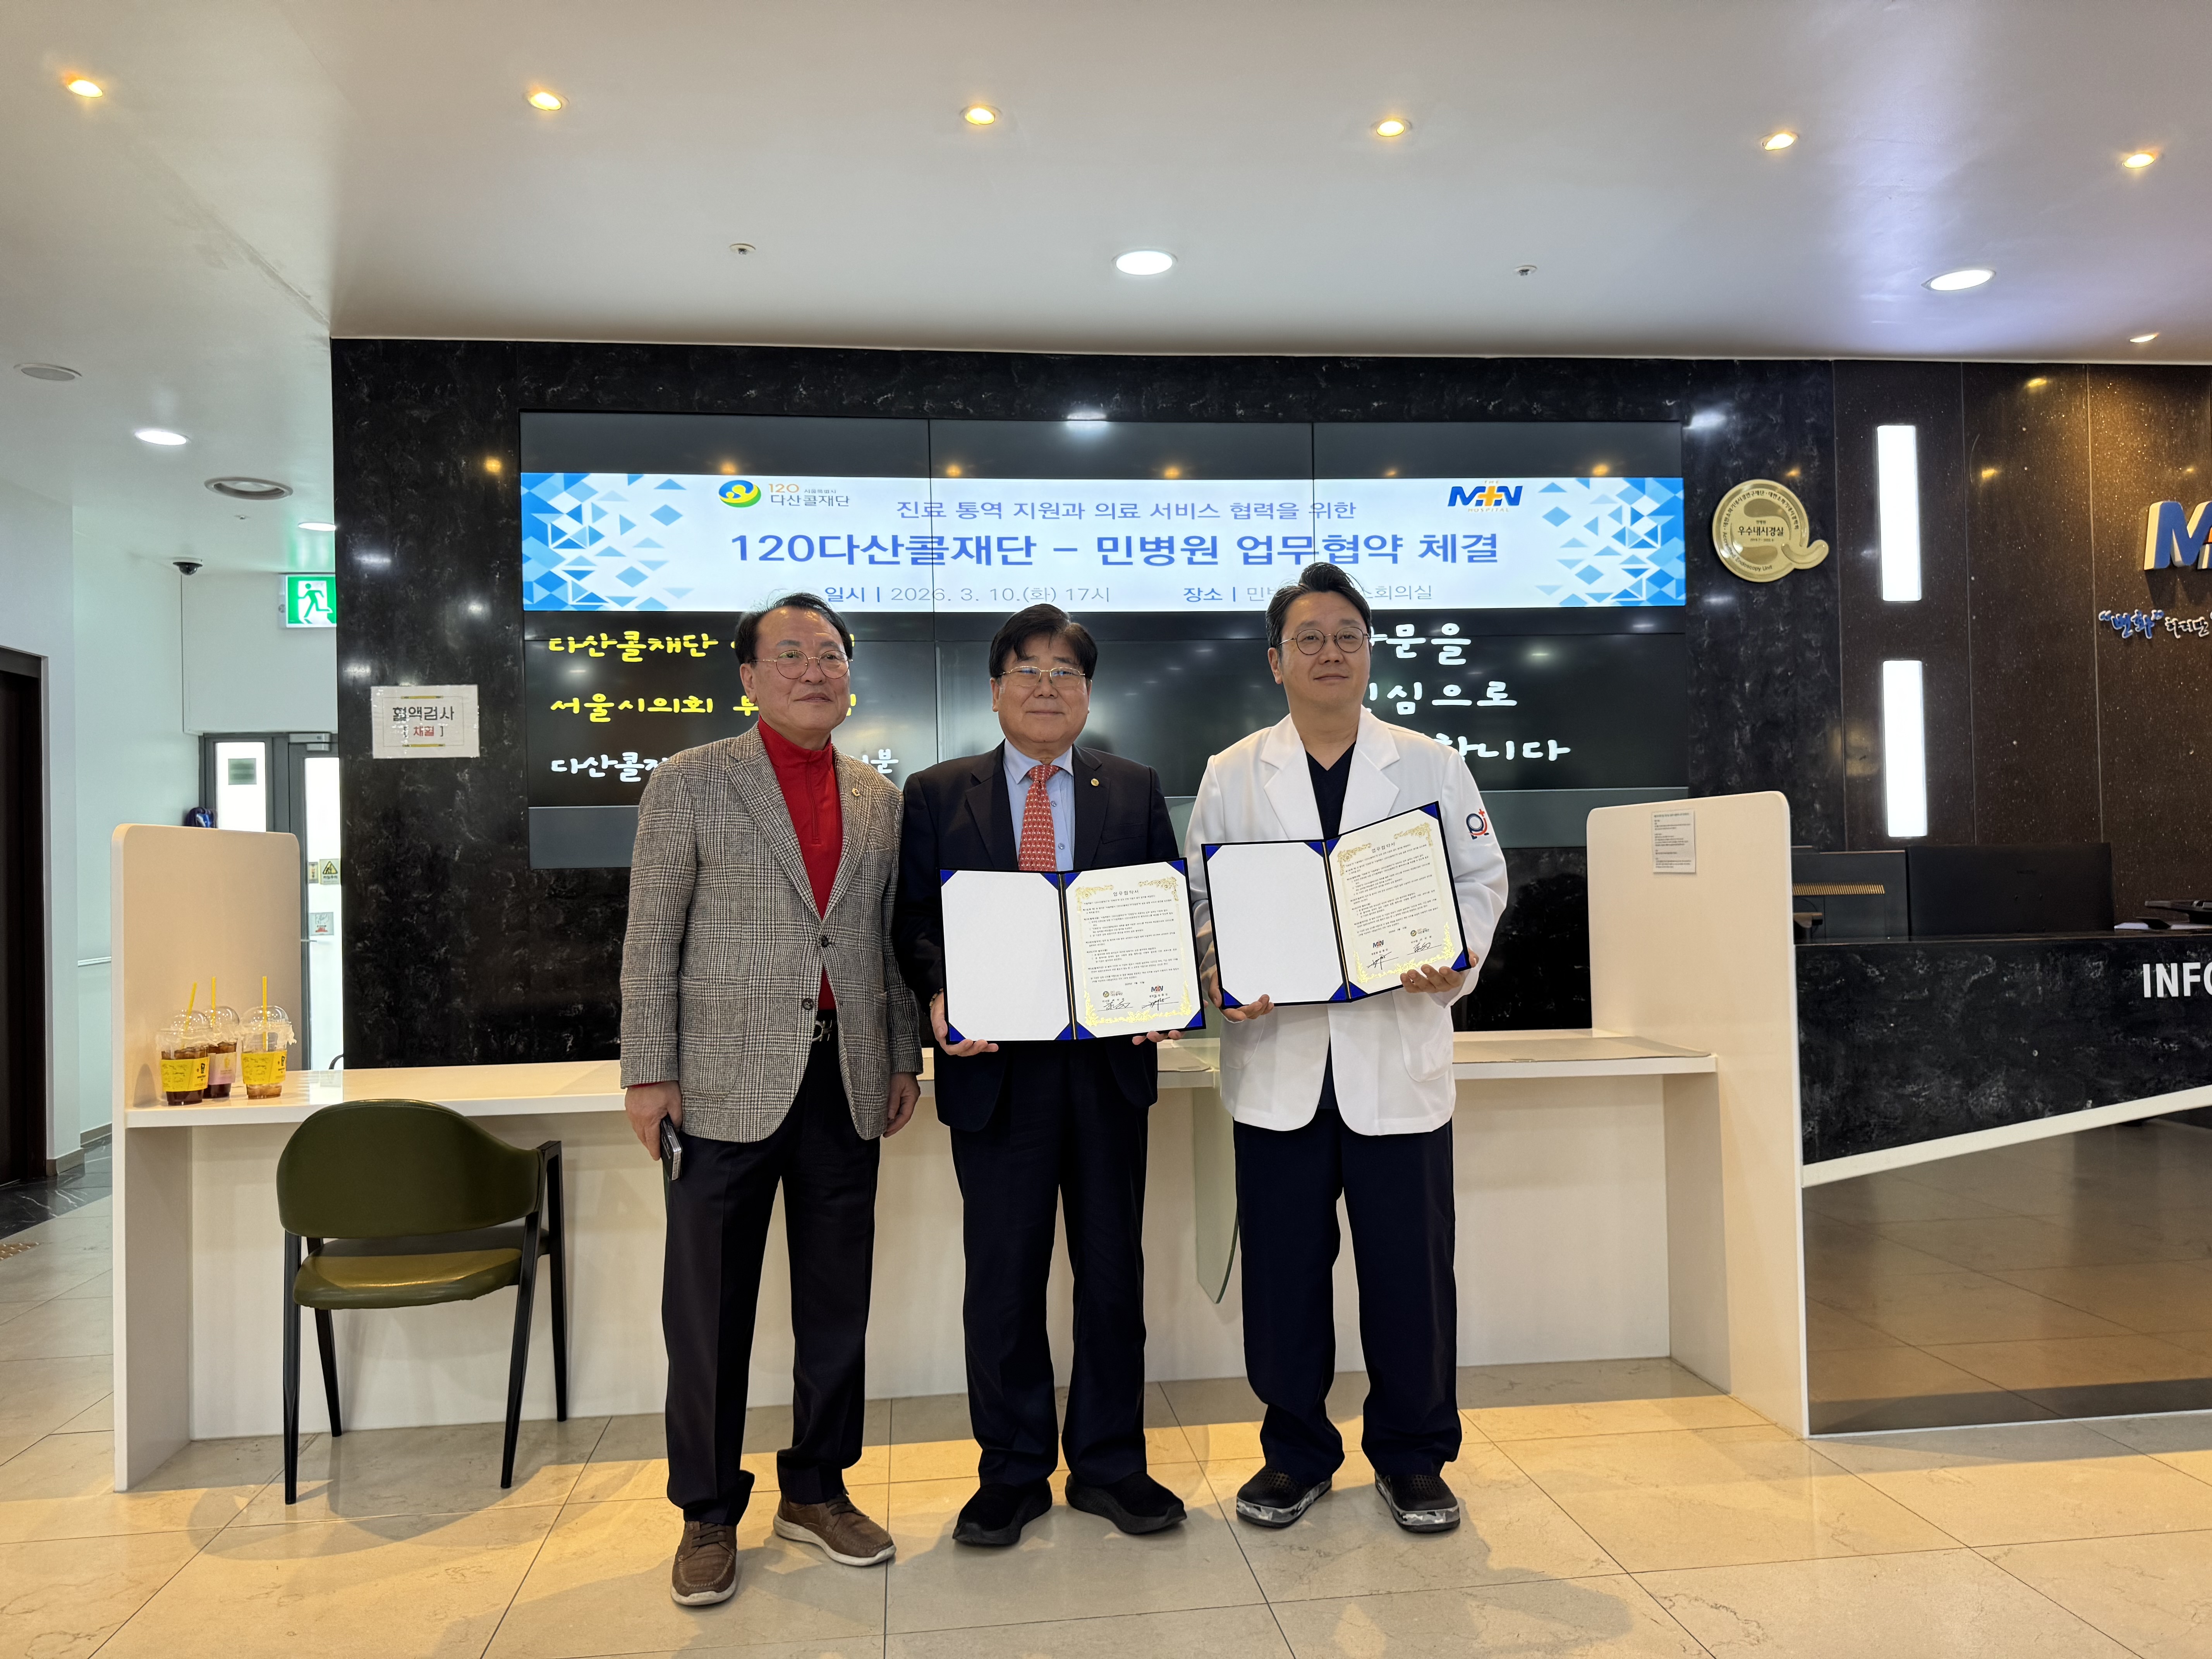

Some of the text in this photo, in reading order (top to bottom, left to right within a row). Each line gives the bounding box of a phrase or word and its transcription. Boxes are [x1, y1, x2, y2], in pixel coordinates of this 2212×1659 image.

[768, 483, 799, 493] 120
[770, 495, 850, 507] 다산콜재단
[896, 501, 1357, 520] 진료 통역 지원과 의료 서비스 협력을 위한
[1737, 526, 1784, 537] 우수내시경실
[732, 534, 1037, 565] 120다산콜재단
[1097, 535, 1218, 567] 민병원
[1237, 533, 1403, 565] 업무협약
[1418, 533, 1498, 564] 체결
[1735, 557, 1761, 572] Endoscopy
[825, 586, 865, 603] 일시
[891, 587, 951, 601] 2026.
[960, 588, 979, 601] 3.
[989, 587, 1056, 603] 10.(화)
[1066, 587, 1110, 603] 17시
[1183, 587, 1223, 602] 장소
[548, 630, 719, 663] 다산콜재단
[393, 706, 455, 721] 혈액검사
[550, 692, 713, 723] 서울시의회
[1371, 841, 1396, 853] 업무협약서
